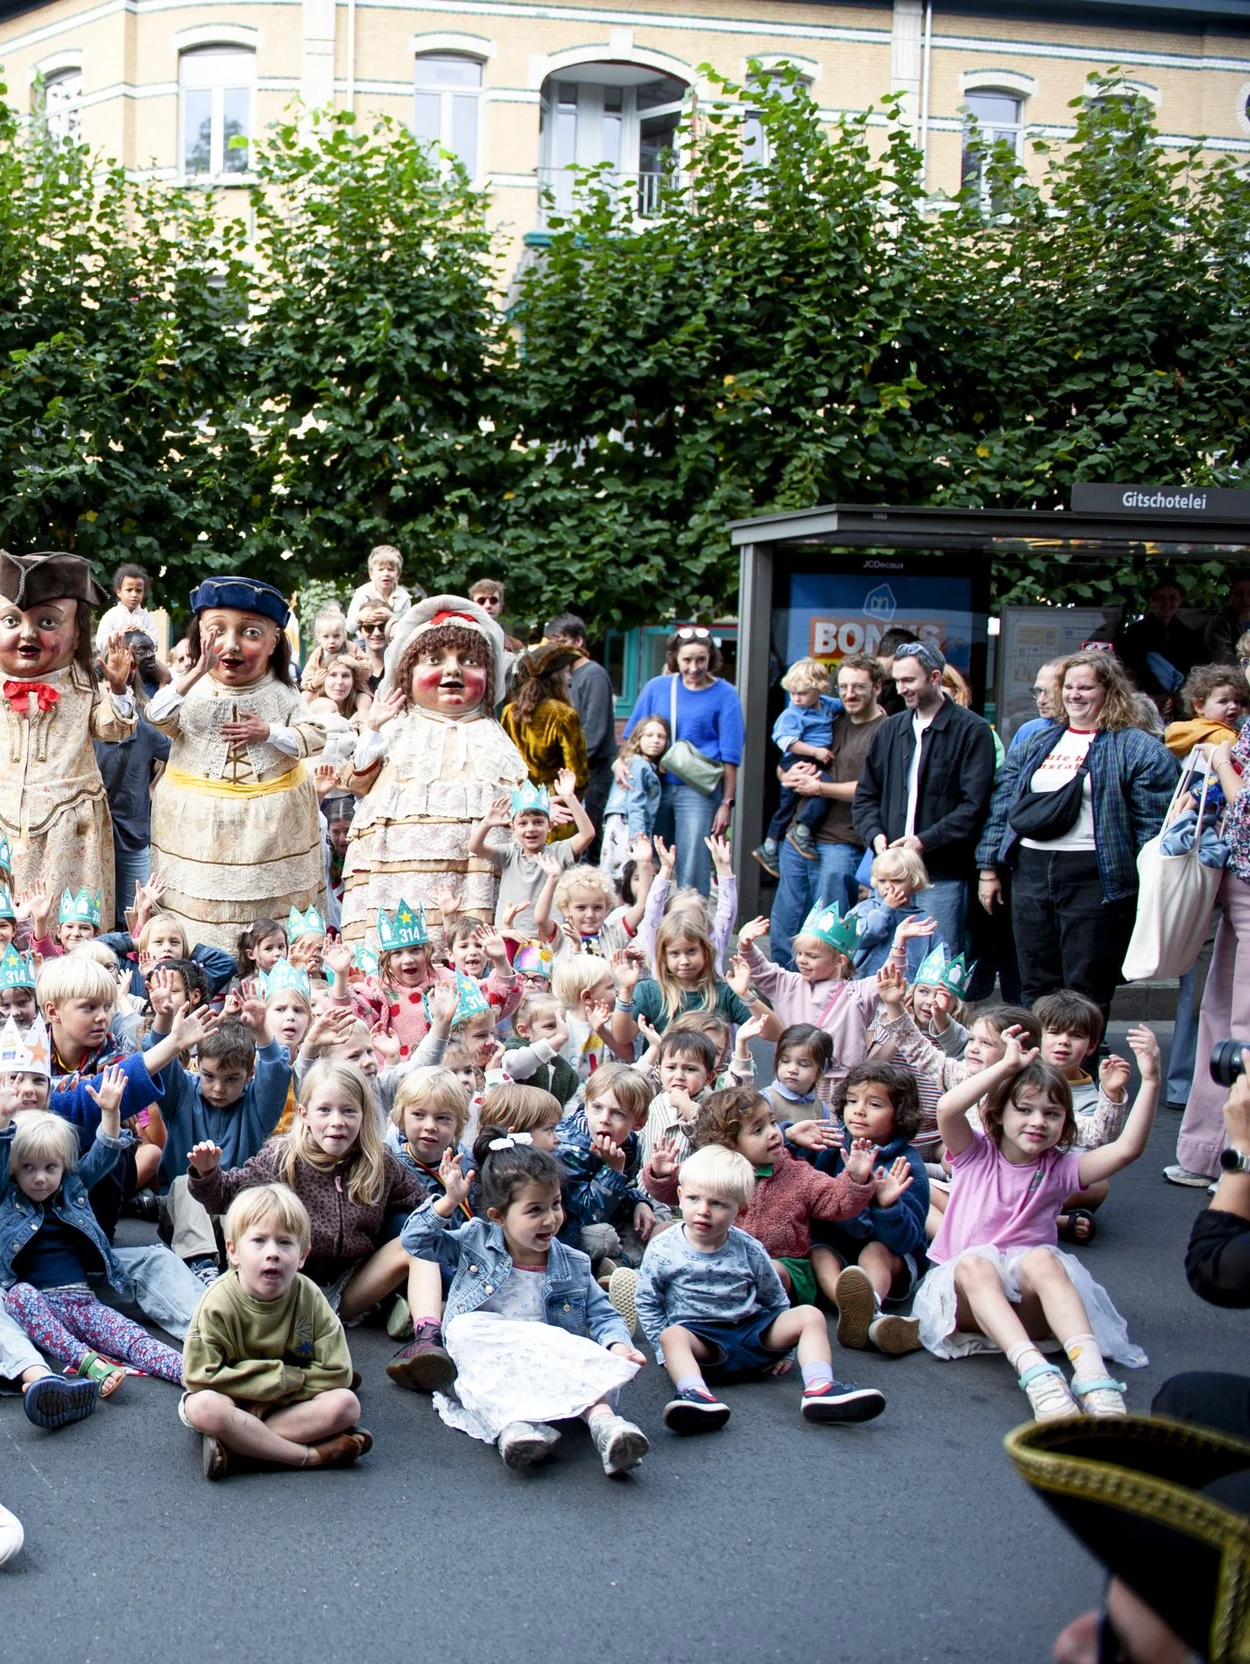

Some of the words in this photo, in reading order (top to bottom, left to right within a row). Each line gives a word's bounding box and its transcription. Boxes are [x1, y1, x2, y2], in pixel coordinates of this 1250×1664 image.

[1122, 491, 1207, 510] Gitschotelei
[863, 560, 904, 570] JCDecaux
[813, 622, 941, 655] BONS
[398, 926, 421, 944] 314
[5, 969, 26, 984] 314
[465, 993, 485, 1010] 314
